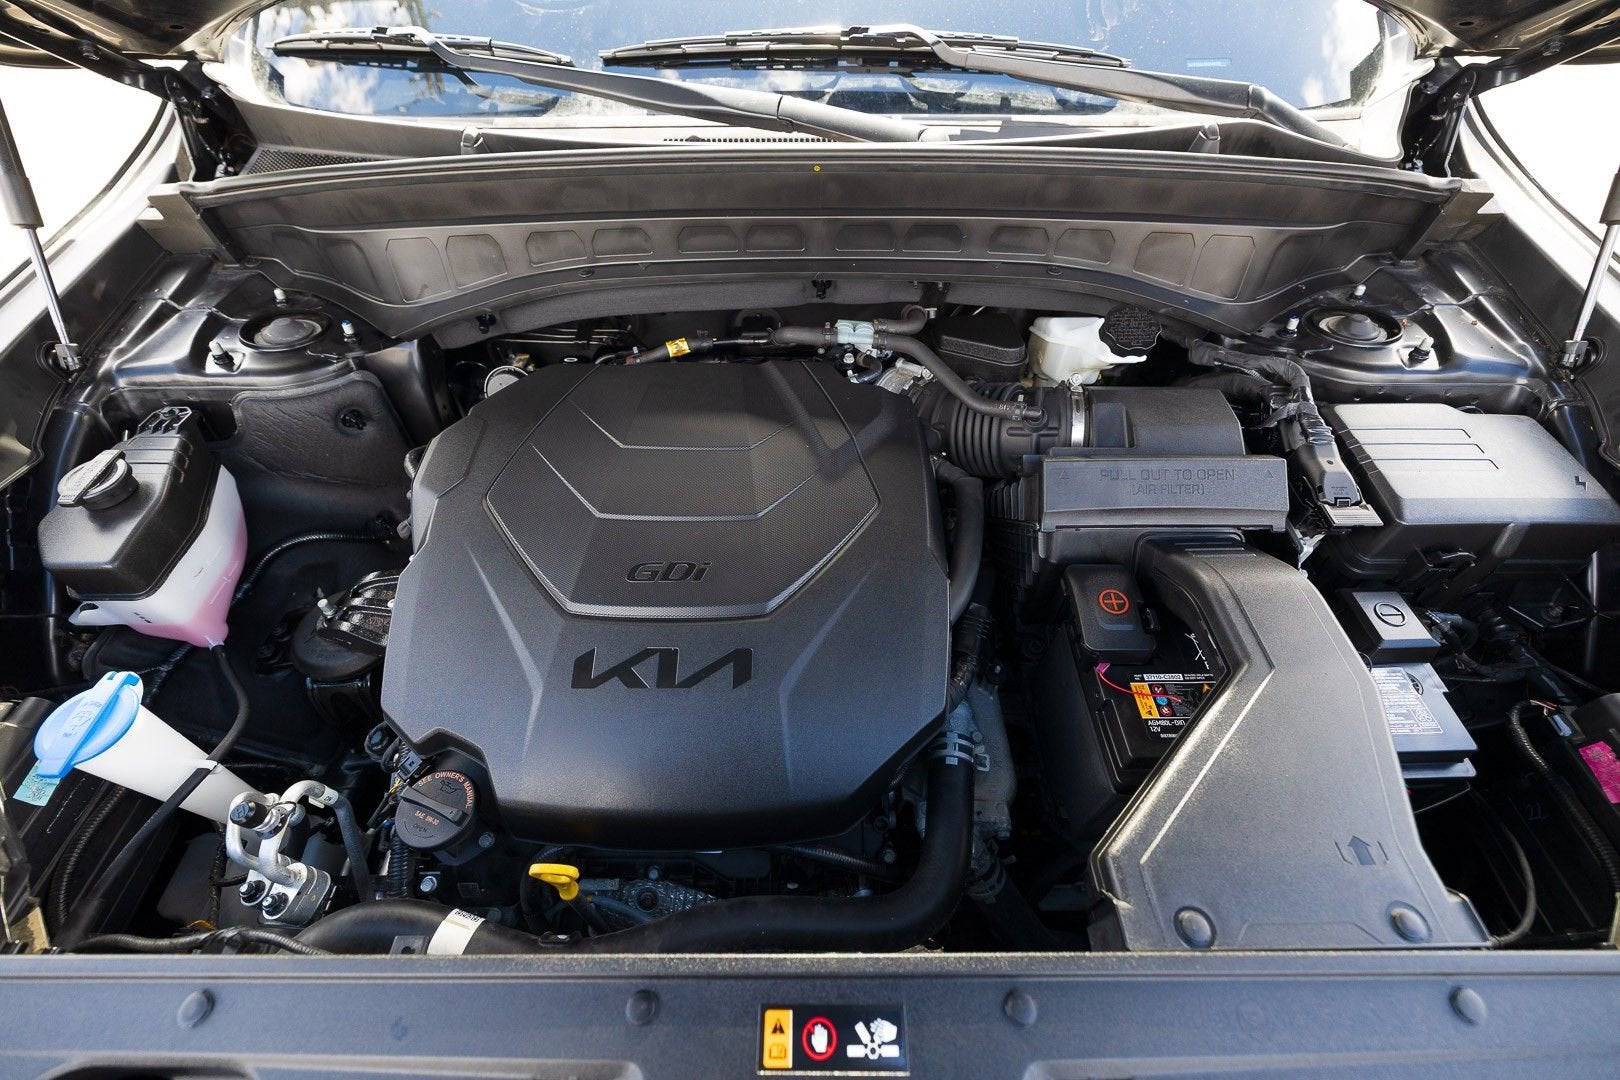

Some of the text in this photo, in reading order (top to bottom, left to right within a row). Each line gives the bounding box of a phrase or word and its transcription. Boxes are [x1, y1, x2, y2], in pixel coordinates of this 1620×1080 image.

[1099, 469, 1235, 481] PULL OUT TO OPEN
[1131, 483, 1206, 496] (AIR FILTER)
[624, 562, 712, 583] GDi
[570, 647, 753, 690] KIA
[418, 771, 473, 809] SEE OWNER'S MANUAL
[414, 810, 426, 819] SAE
